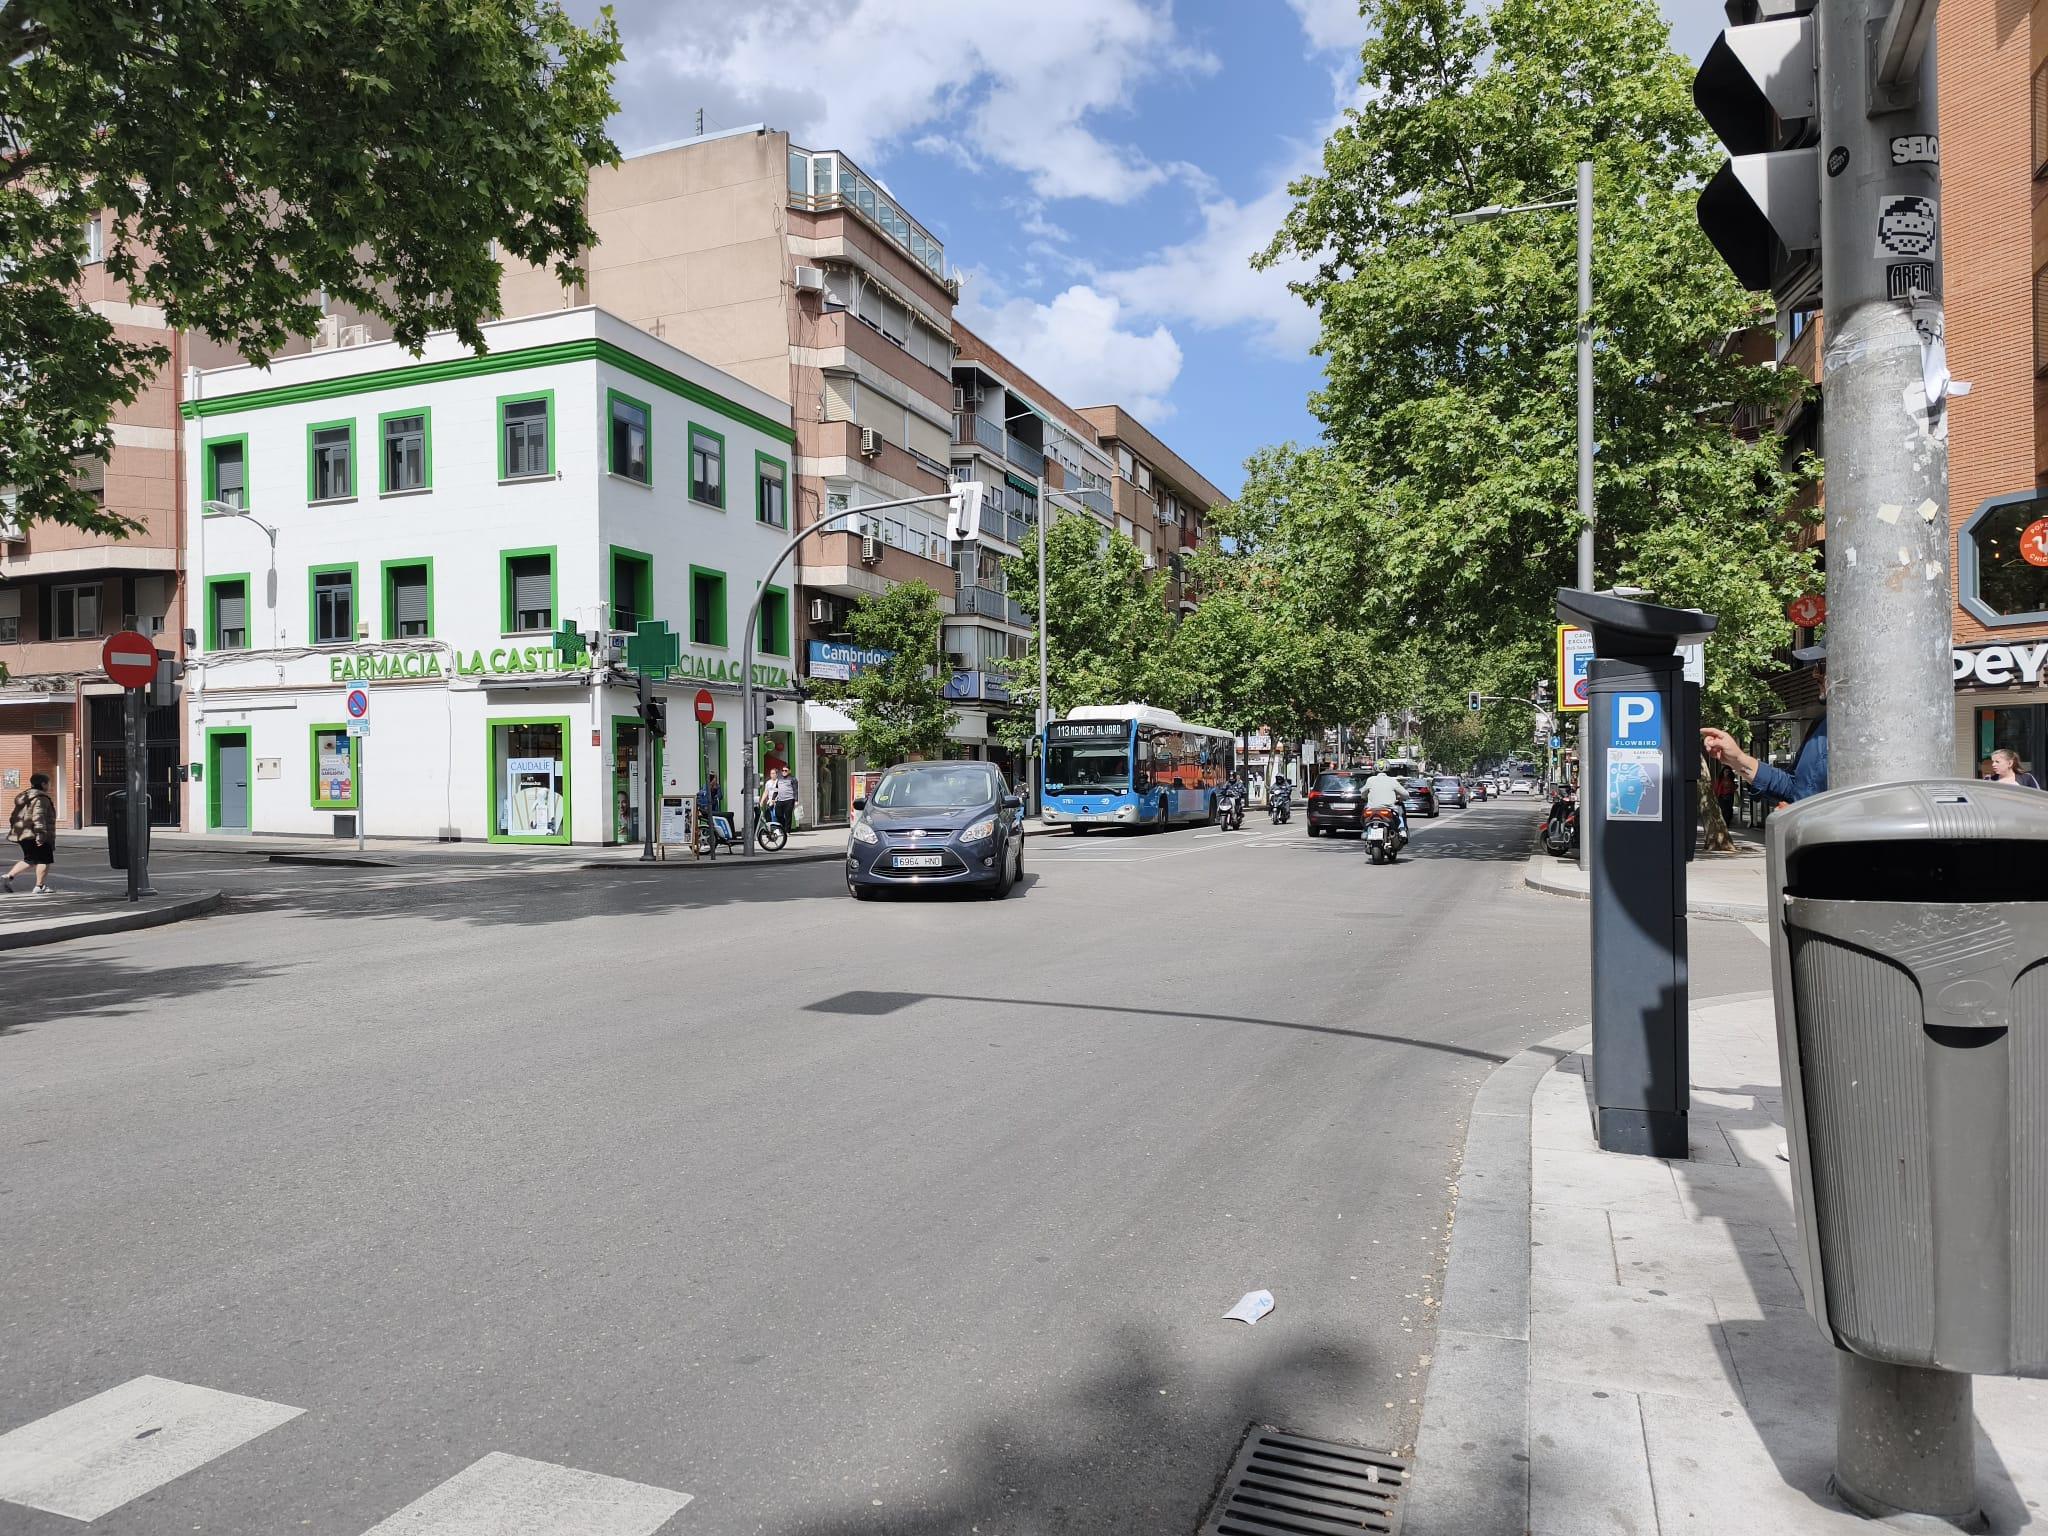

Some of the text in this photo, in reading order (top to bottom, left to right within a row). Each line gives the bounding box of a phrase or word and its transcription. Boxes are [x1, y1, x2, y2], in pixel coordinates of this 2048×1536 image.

[330, 652, 442, 682] FARMACIA
[456, 650, 485, 675] LA
[1057, 724, 1121, 737] 113 MENDEZ ALVARO
[1618, 696, 1655, 739] P
